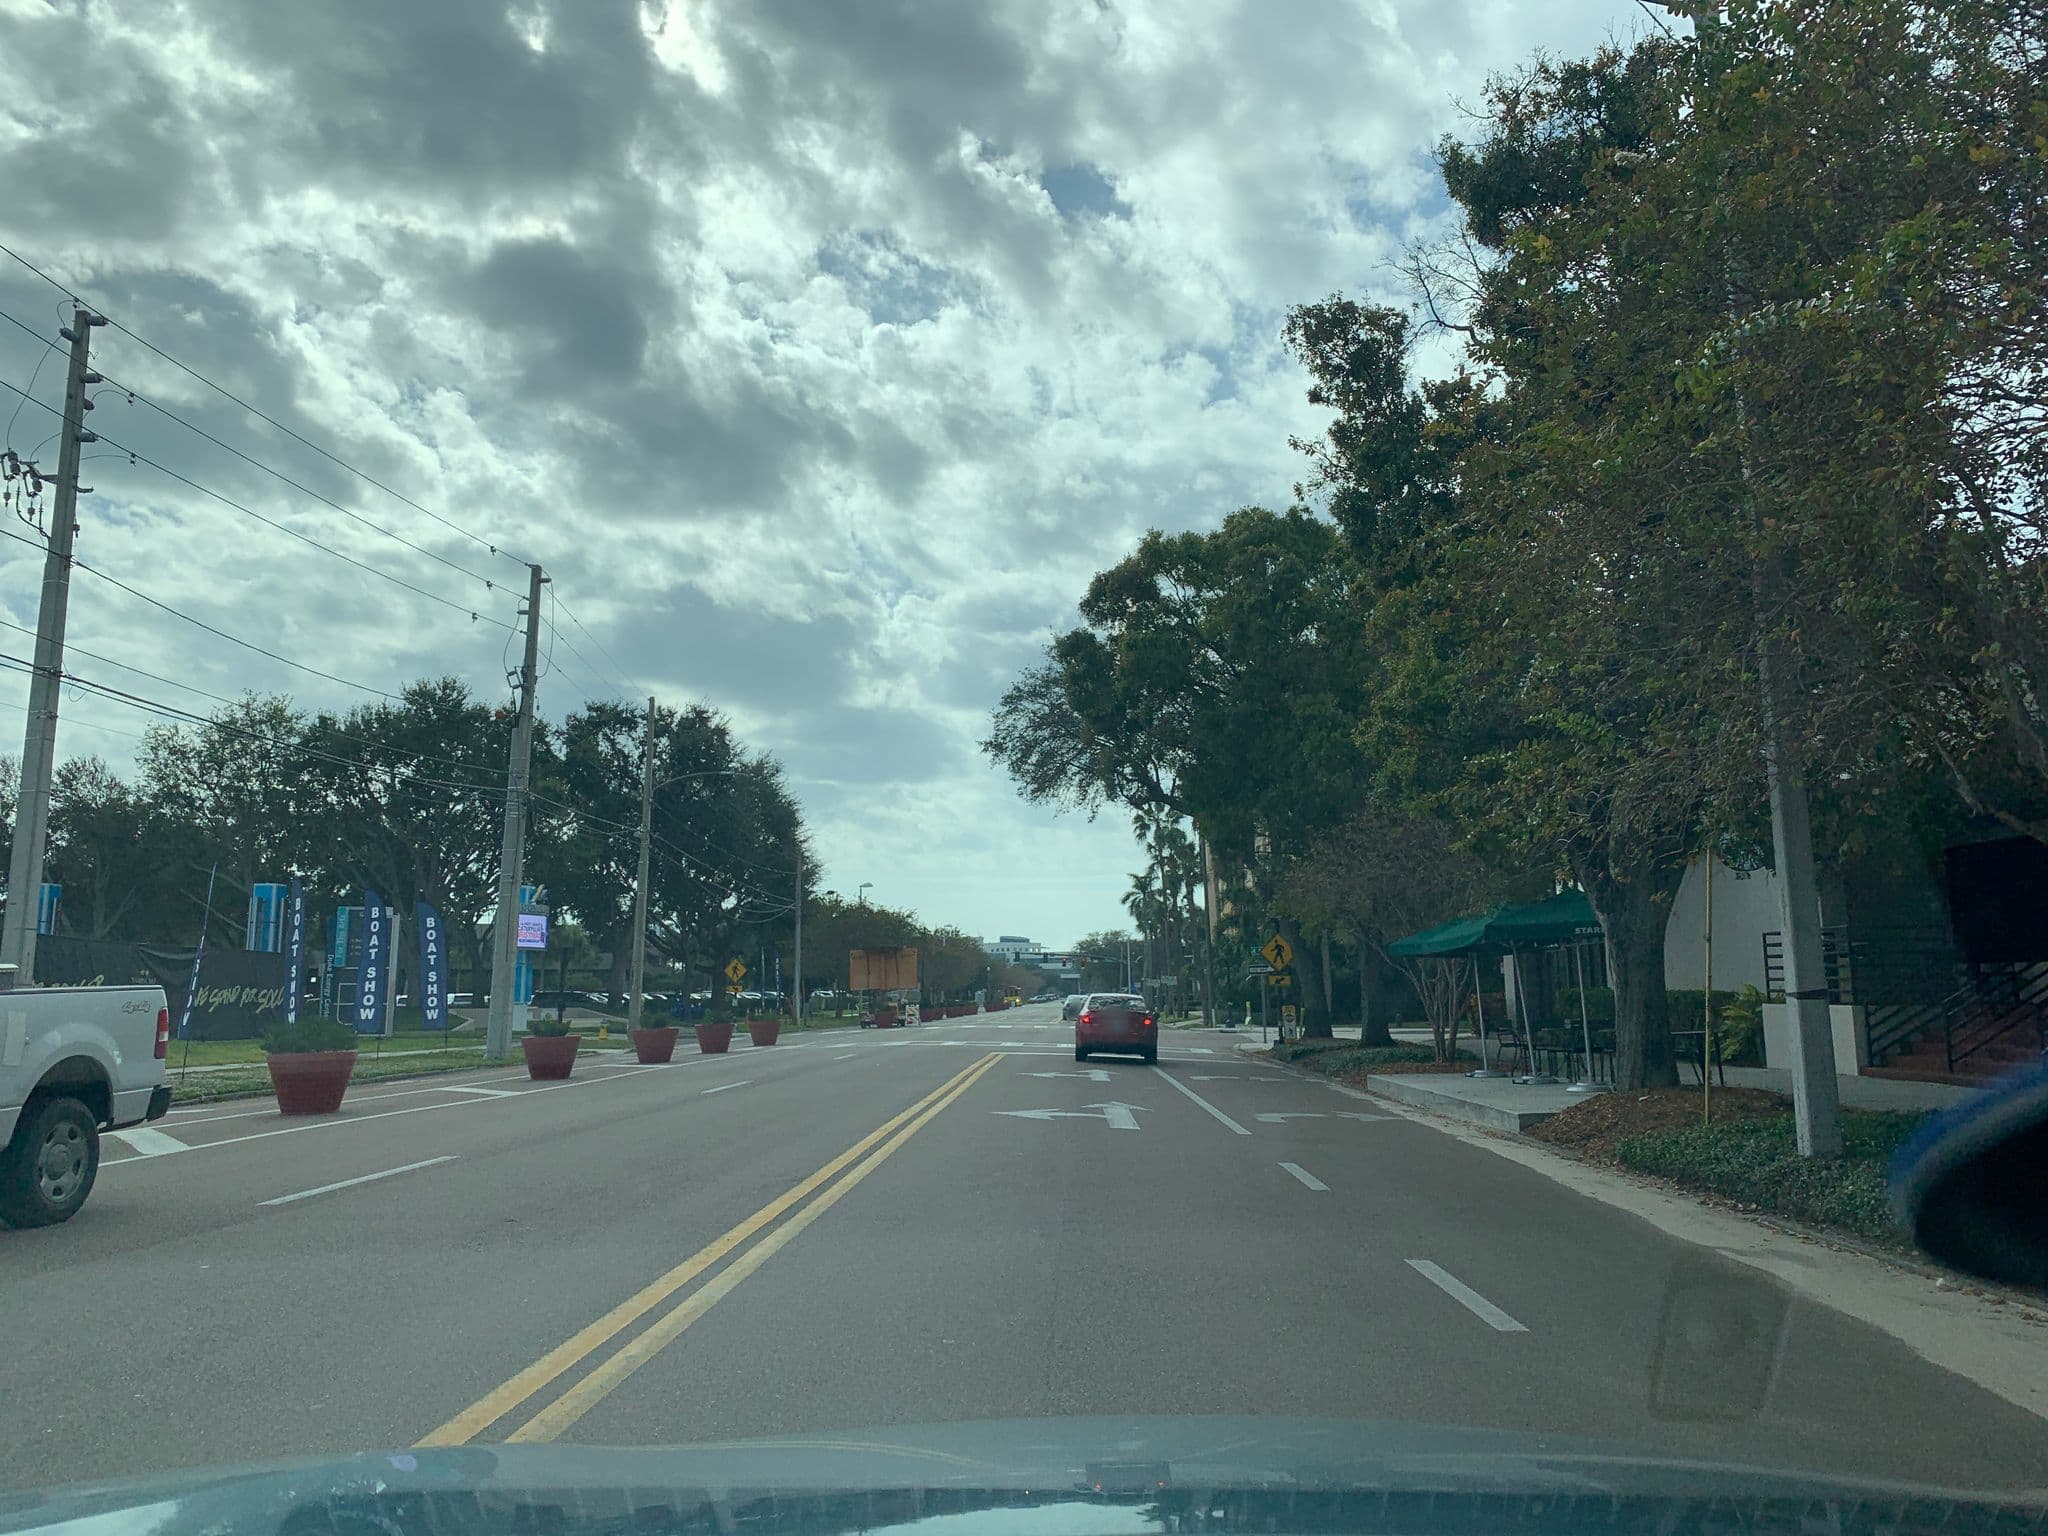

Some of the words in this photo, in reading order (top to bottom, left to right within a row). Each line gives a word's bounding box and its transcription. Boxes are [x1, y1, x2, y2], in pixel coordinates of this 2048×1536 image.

[291, 898, 301, 957] BOAT
[369, 907, 380, 960] BOAT
[426, 917, 437, 965] BOAT
[287, 965, 297, 1024] SHOW
[359, 967, 377, 1019] SHOW
[426, 971, 439, 1020] SHOW
